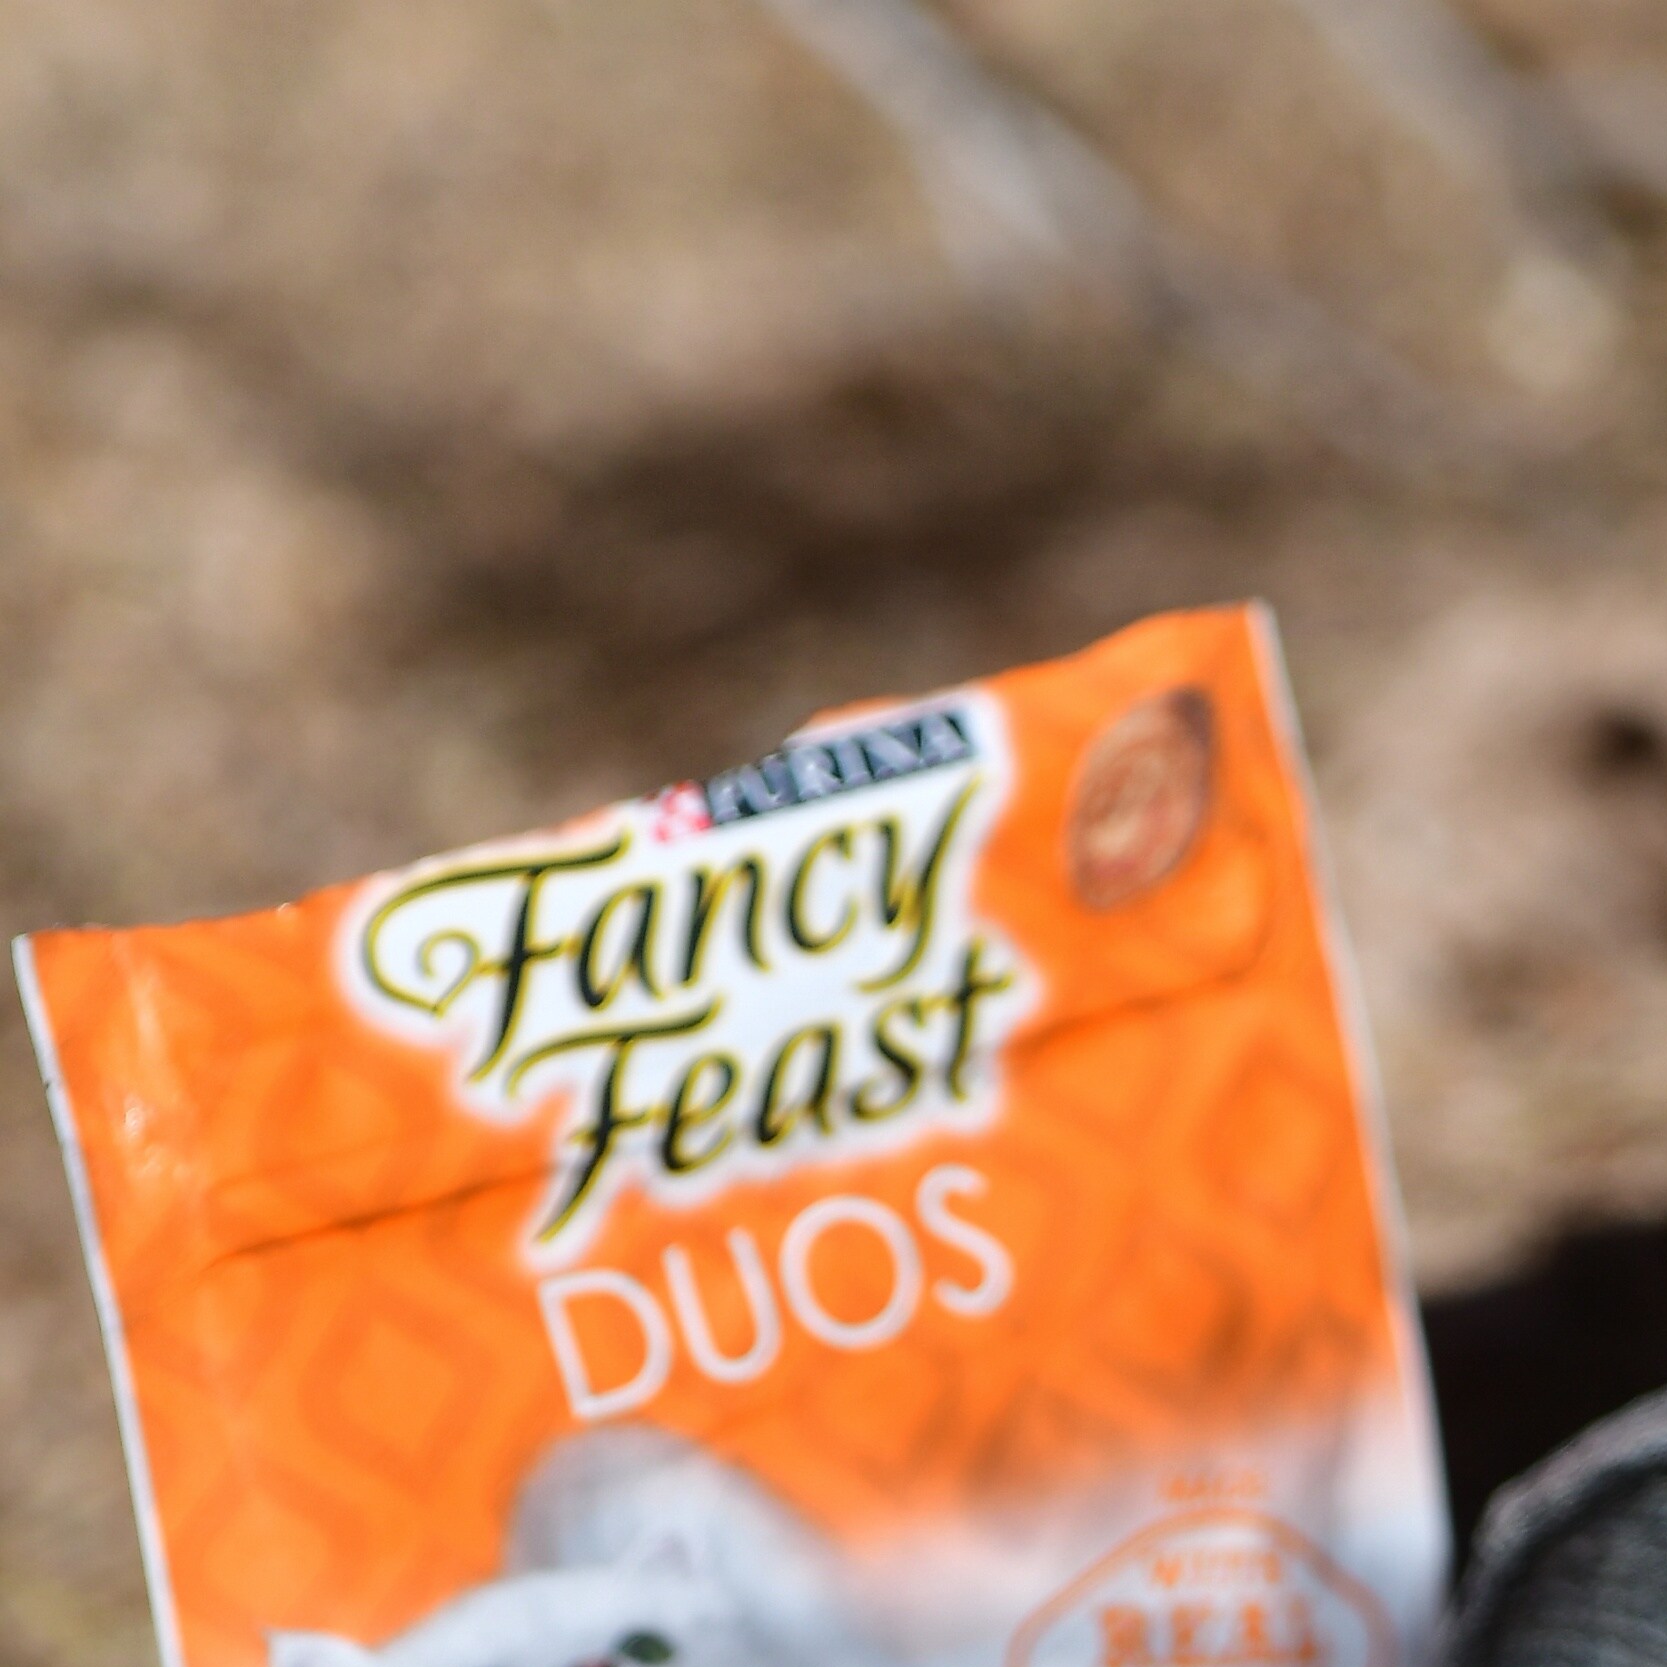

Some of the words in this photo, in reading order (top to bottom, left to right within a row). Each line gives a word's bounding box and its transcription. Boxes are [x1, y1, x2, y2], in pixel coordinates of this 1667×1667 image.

[360, 772, 983, 1084] Fancy
[505, 938, 1012, 1247] Feast
[538, 1165, 1012, 1420] DUOS
